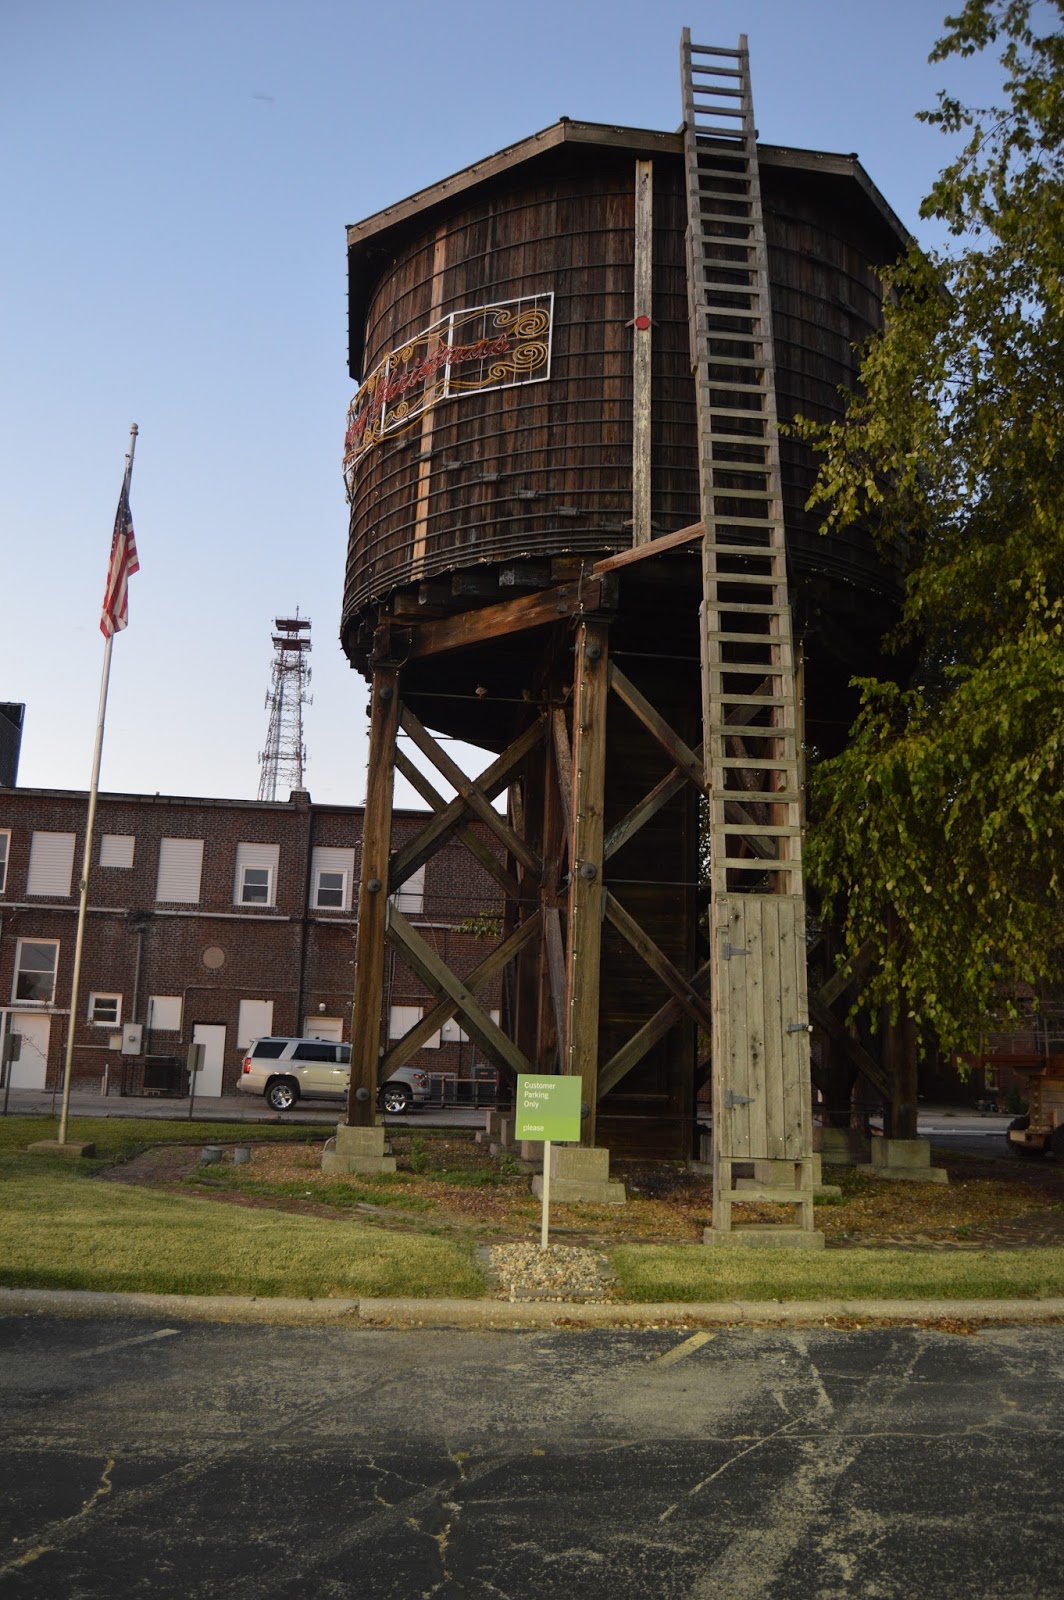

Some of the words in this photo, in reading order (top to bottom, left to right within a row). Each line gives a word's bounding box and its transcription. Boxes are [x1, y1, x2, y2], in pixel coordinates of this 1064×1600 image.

[524, 1081, 556, 1090] Customer
[524, 1091, 549, 1100] Parking
[523, 1100, 539, 1109] Only
[522, 1124, 545, 1132] please
